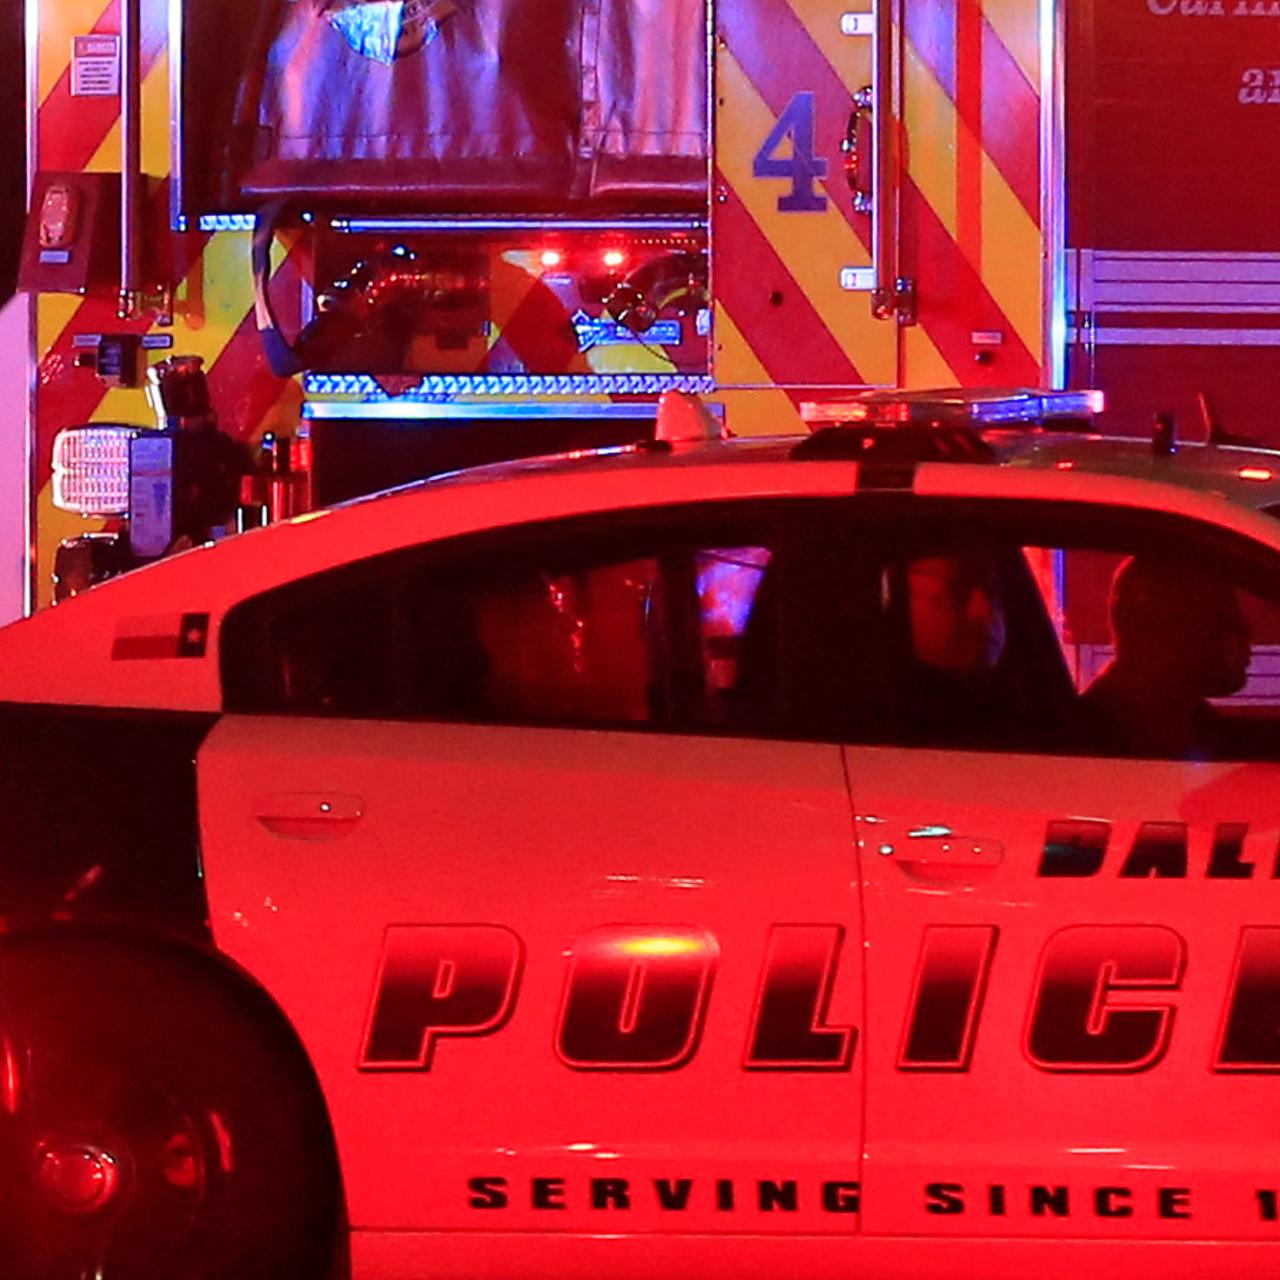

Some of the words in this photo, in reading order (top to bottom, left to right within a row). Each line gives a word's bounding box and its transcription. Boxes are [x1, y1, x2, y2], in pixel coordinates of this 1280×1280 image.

[752, 91, 830, 213] 4
[466, 1176, 863, 1214] SERVING
[923, 1181, 1195, 1220] SINCE
